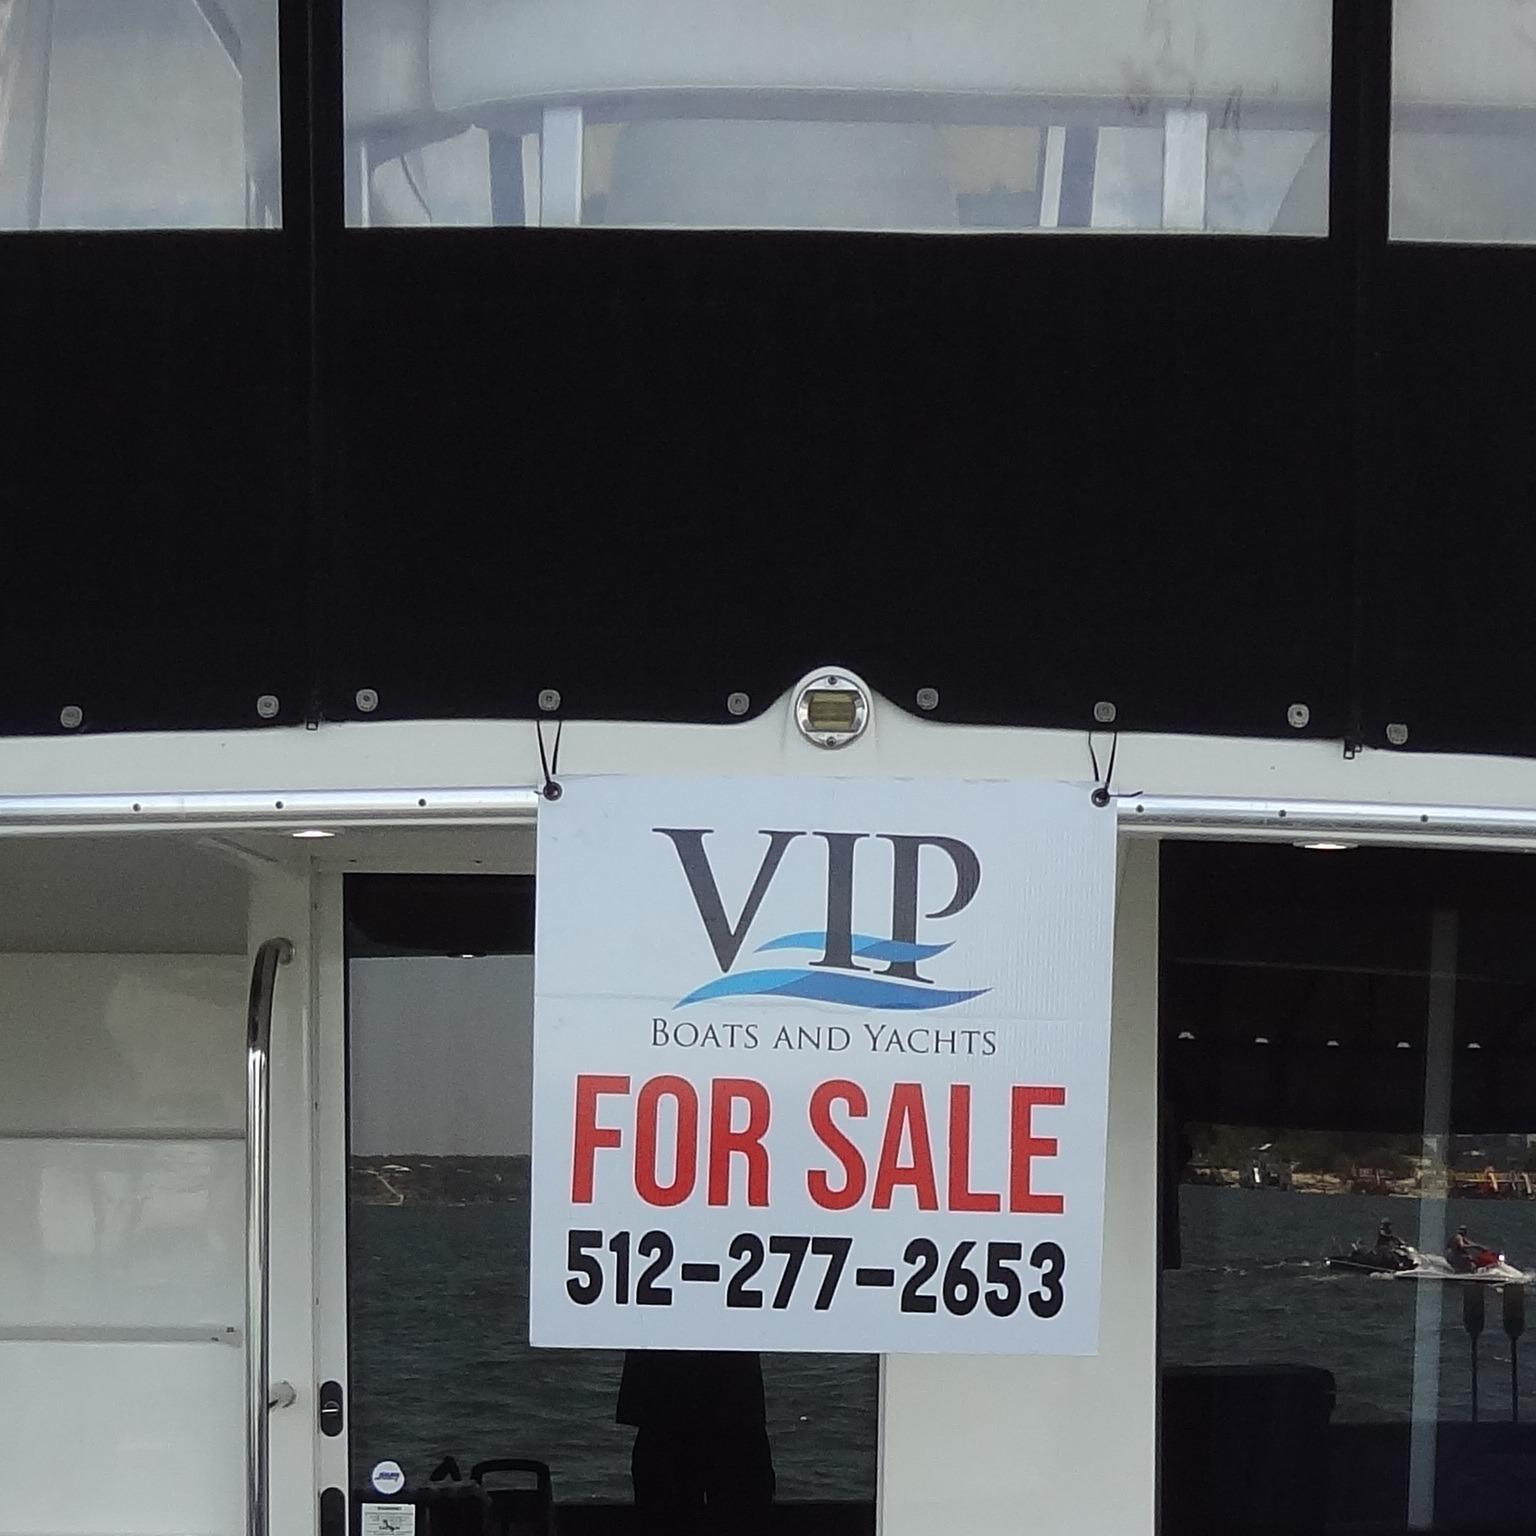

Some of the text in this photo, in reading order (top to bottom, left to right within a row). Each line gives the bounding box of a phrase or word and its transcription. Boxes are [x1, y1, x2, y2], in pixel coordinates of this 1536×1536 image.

[652, 828, 982, 985] VIP
[773, 1026, 851, 1052] AND
[571, 1075, 1066, 1214] FOR SALE
[565, 1230, 1066, 1318] 512-277-2653
